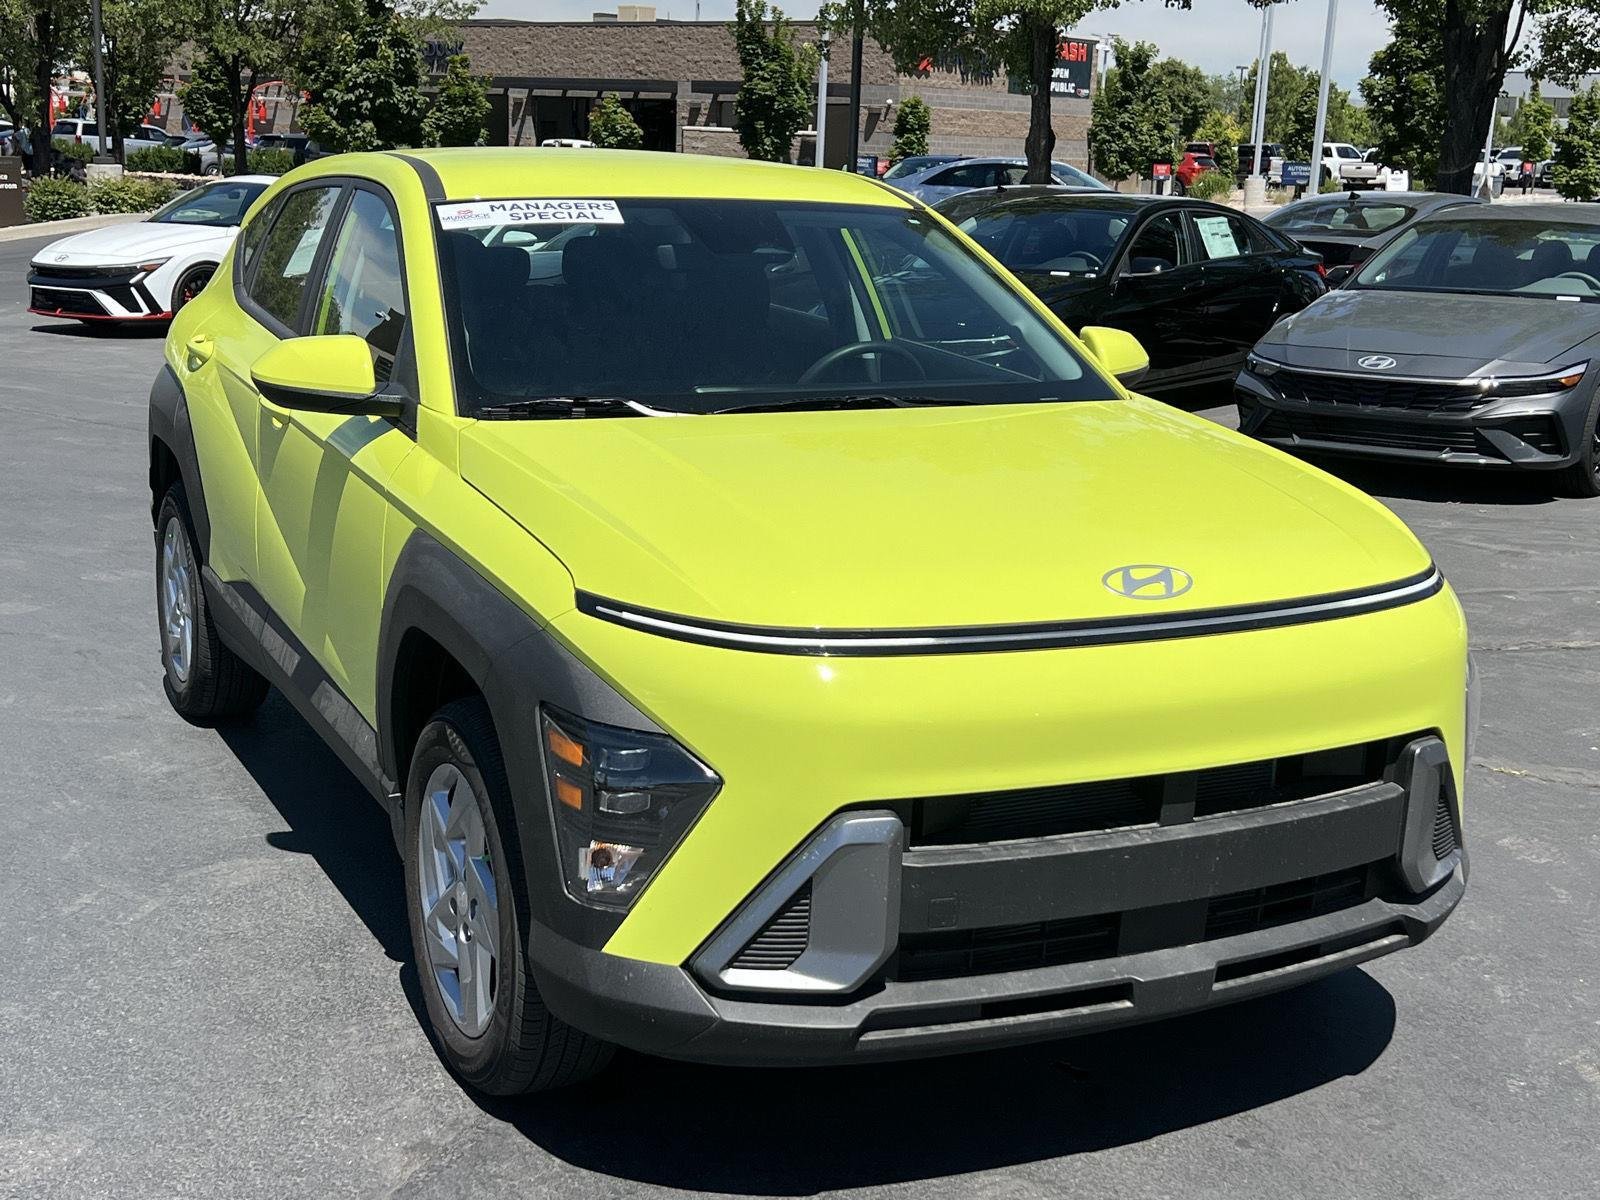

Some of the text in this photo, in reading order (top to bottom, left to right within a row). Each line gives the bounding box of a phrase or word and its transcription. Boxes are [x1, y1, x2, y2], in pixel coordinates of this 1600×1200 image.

[1056, 42, 1088, 62] ASH
[1050, 81, 1076, 93] PUBLIC
[490, 202, 615, 212] MANAGERS
[509, 211, 604, 221] SPECIAL
